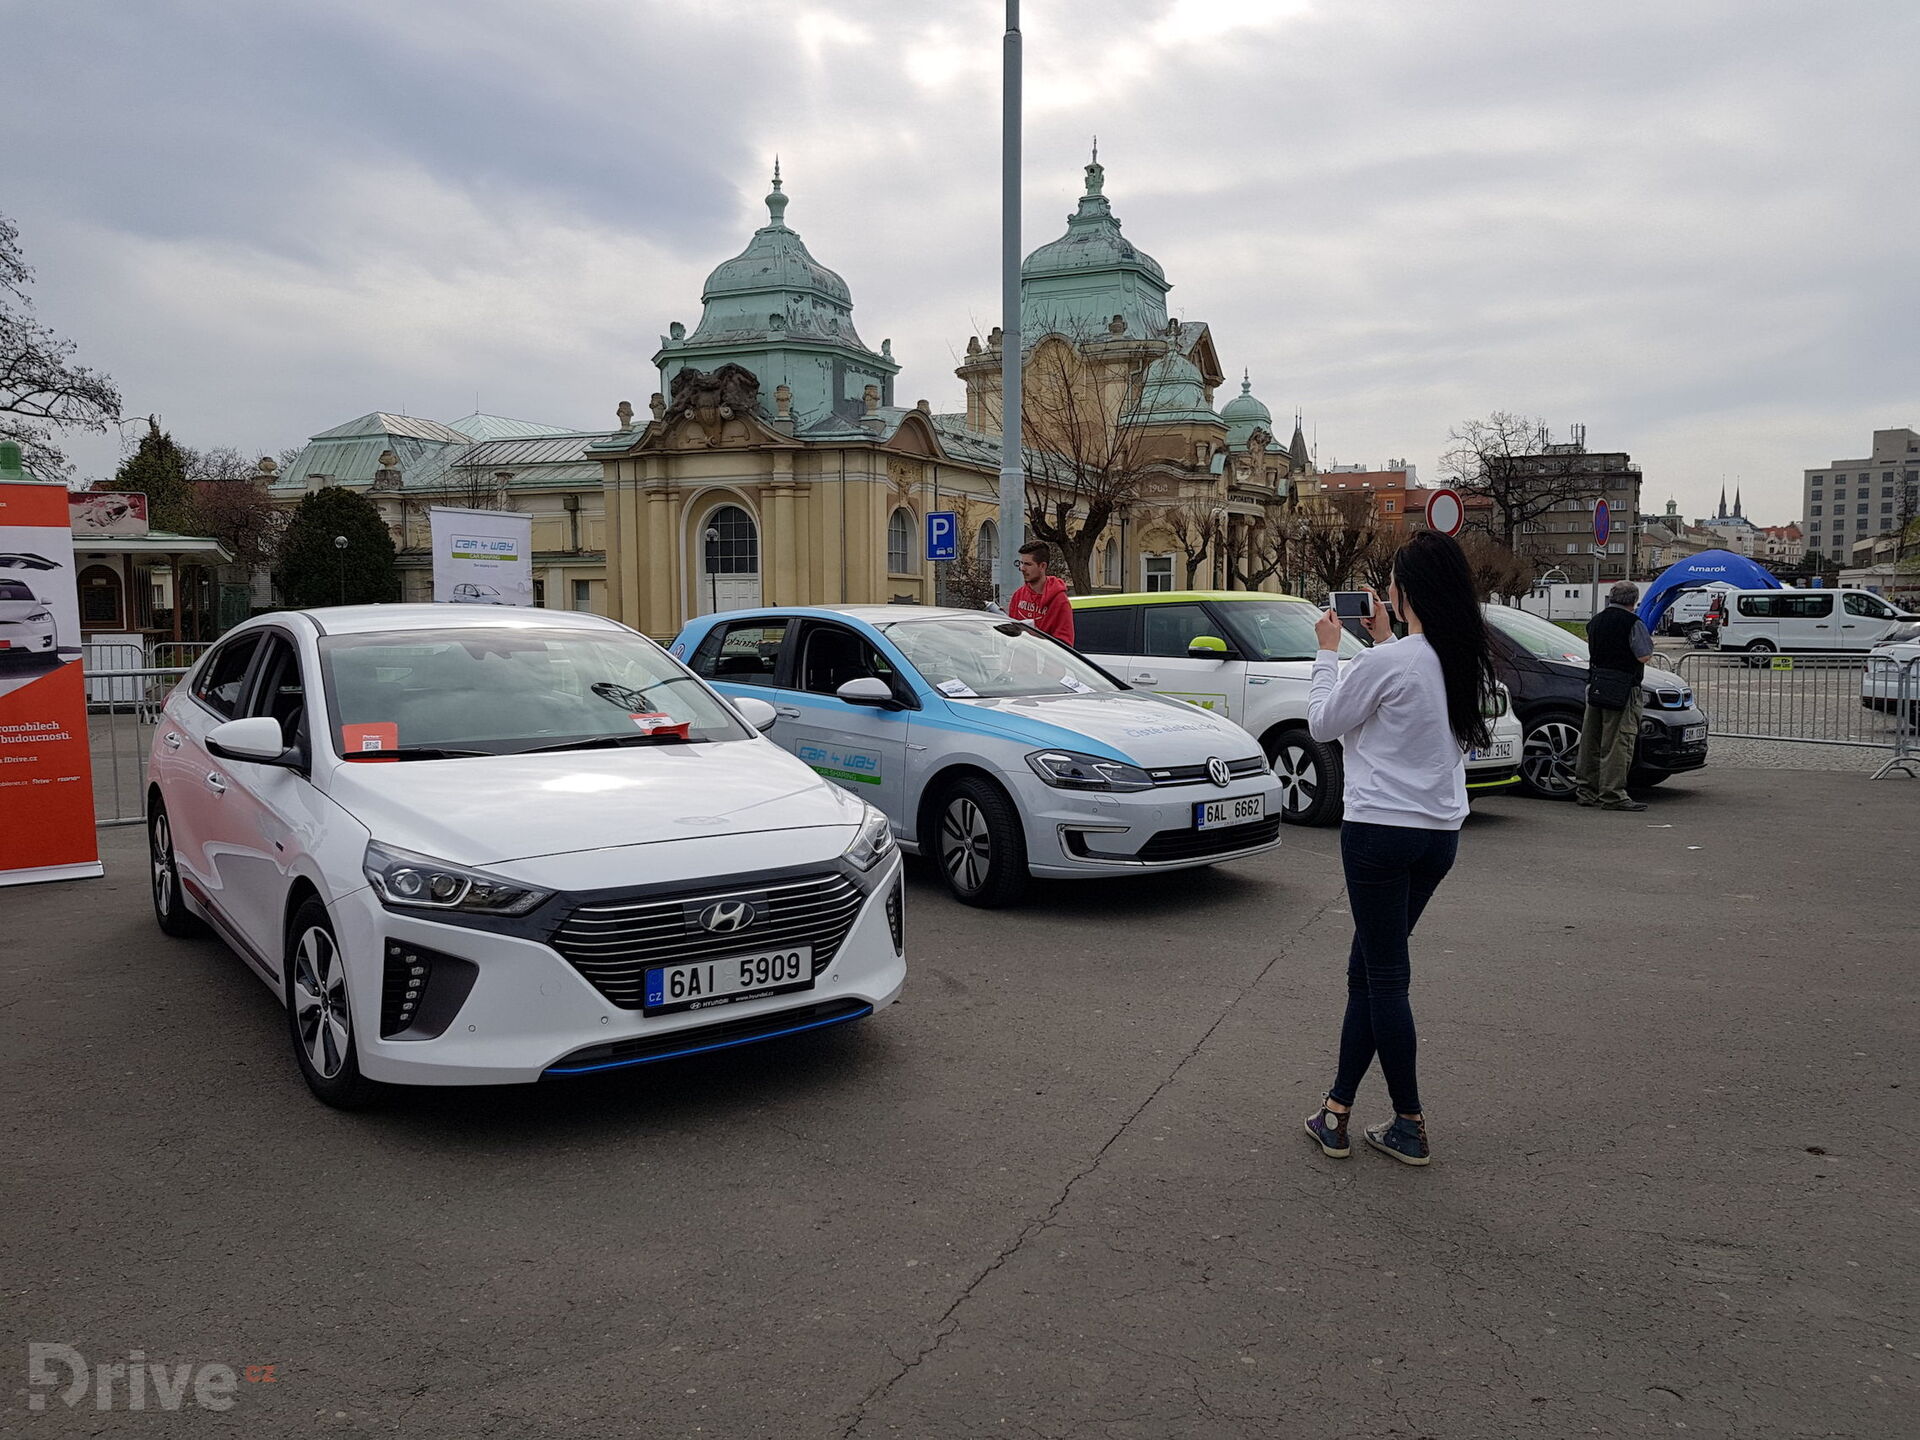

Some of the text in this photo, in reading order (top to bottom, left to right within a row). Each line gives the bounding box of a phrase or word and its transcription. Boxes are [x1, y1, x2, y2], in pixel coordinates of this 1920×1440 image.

[933, 518, 950, 545] P
[1, 731, 72, 744] budoucnosti.
[1495, 743, 1511, 757] 3142
[1207, 804, 1227, 822] 6AL
[1234, 798, 1260, 818] 6662
[648, 991, 662, 1001] CZ
[740, 952, 800, 987] 5909
[702, 998, 730, 1008] HYUNDAI
